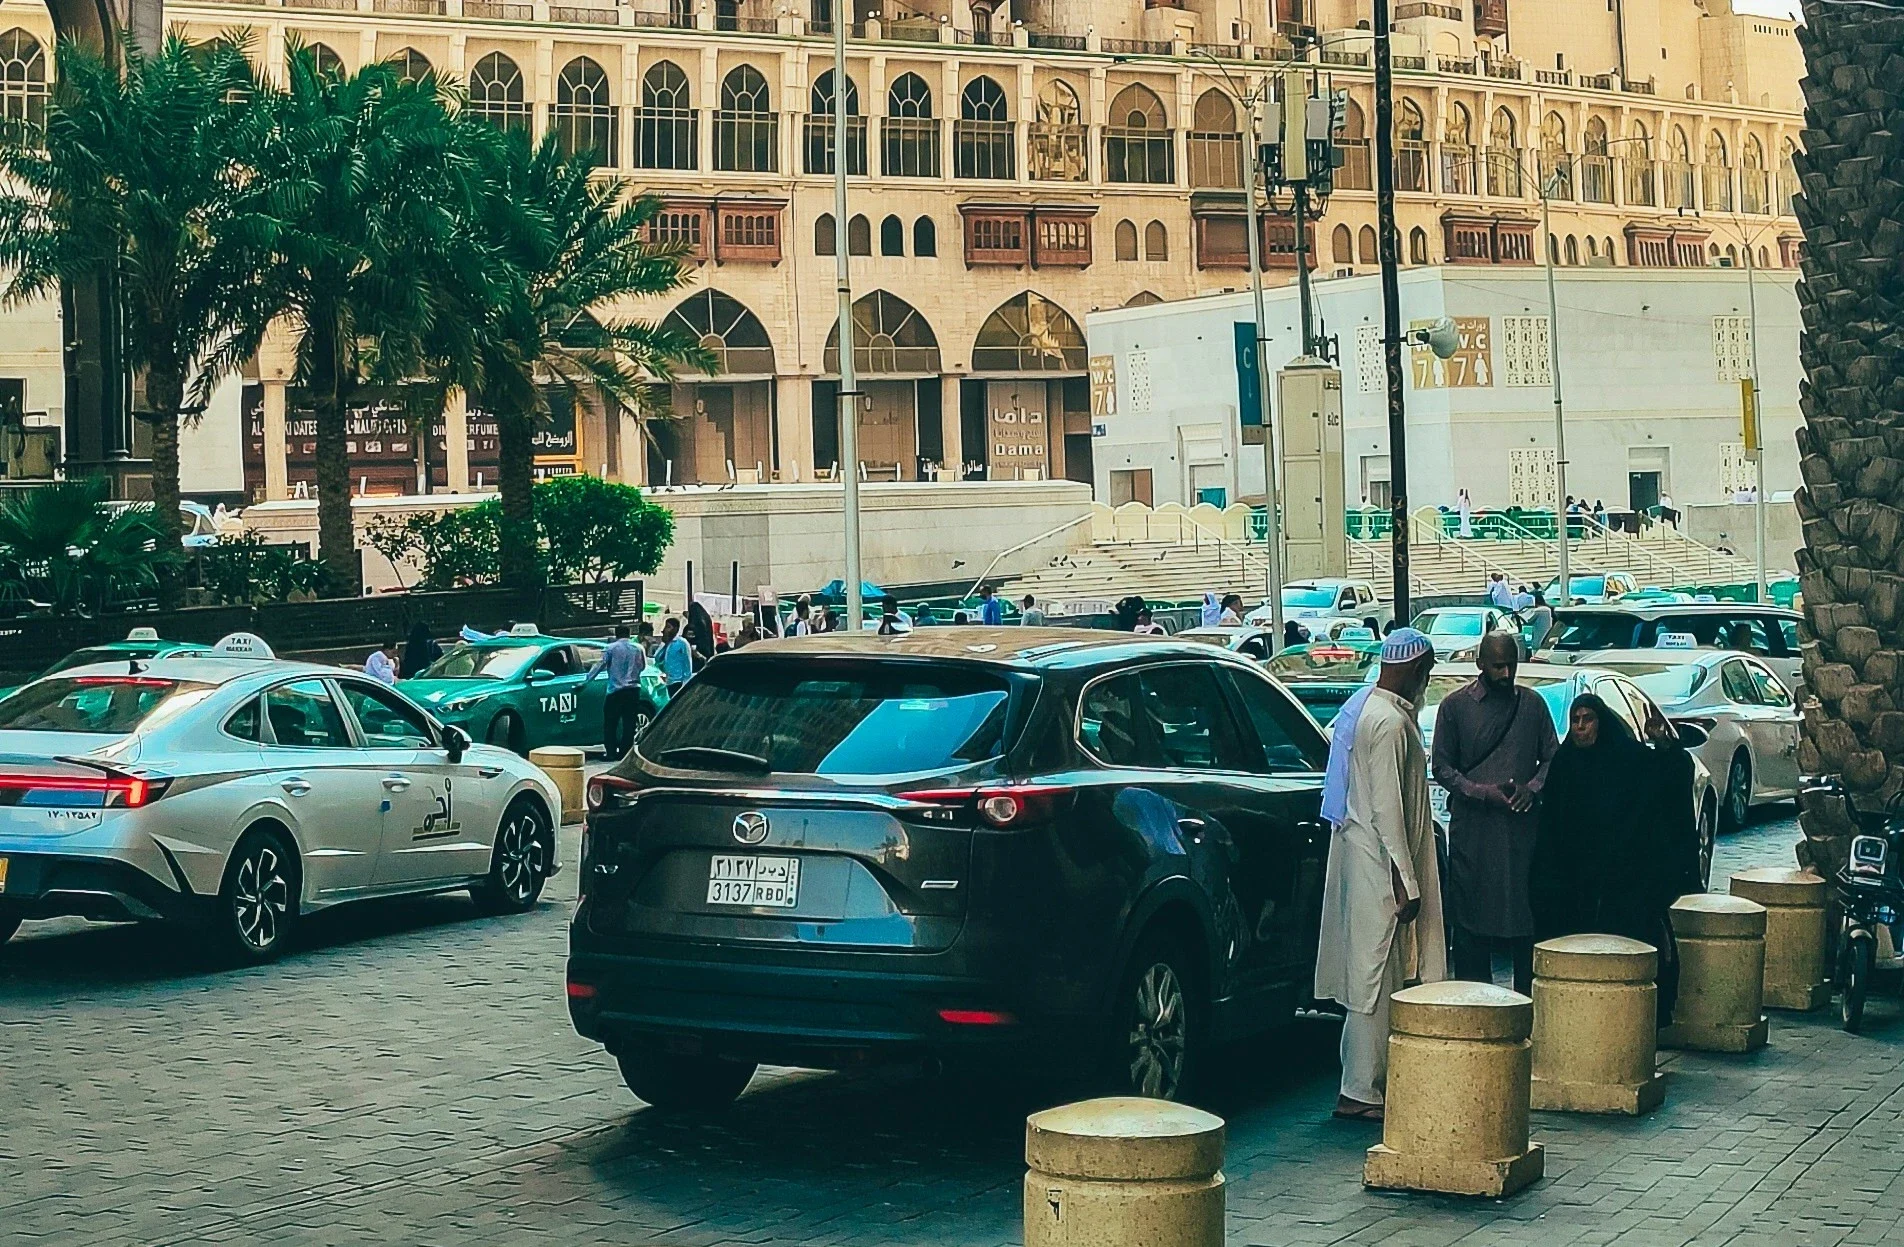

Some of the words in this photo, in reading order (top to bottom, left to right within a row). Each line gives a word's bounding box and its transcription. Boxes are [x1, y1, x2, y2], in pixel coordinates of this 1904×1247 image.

[1416, 359, 1428, 388] 7
[1453, 357, 1467, 386] 7
[1094, 390, 1104, 415] 7
[994, 408, 1042, 424] داما
[995, 443, 1044, 456] Dama
[231, 637, 252, 645] TAXI
[539, 692, 578, 713] TAXI
[712, 882, 752, 902] 3137
[756, 887, 784, 902] RBD
